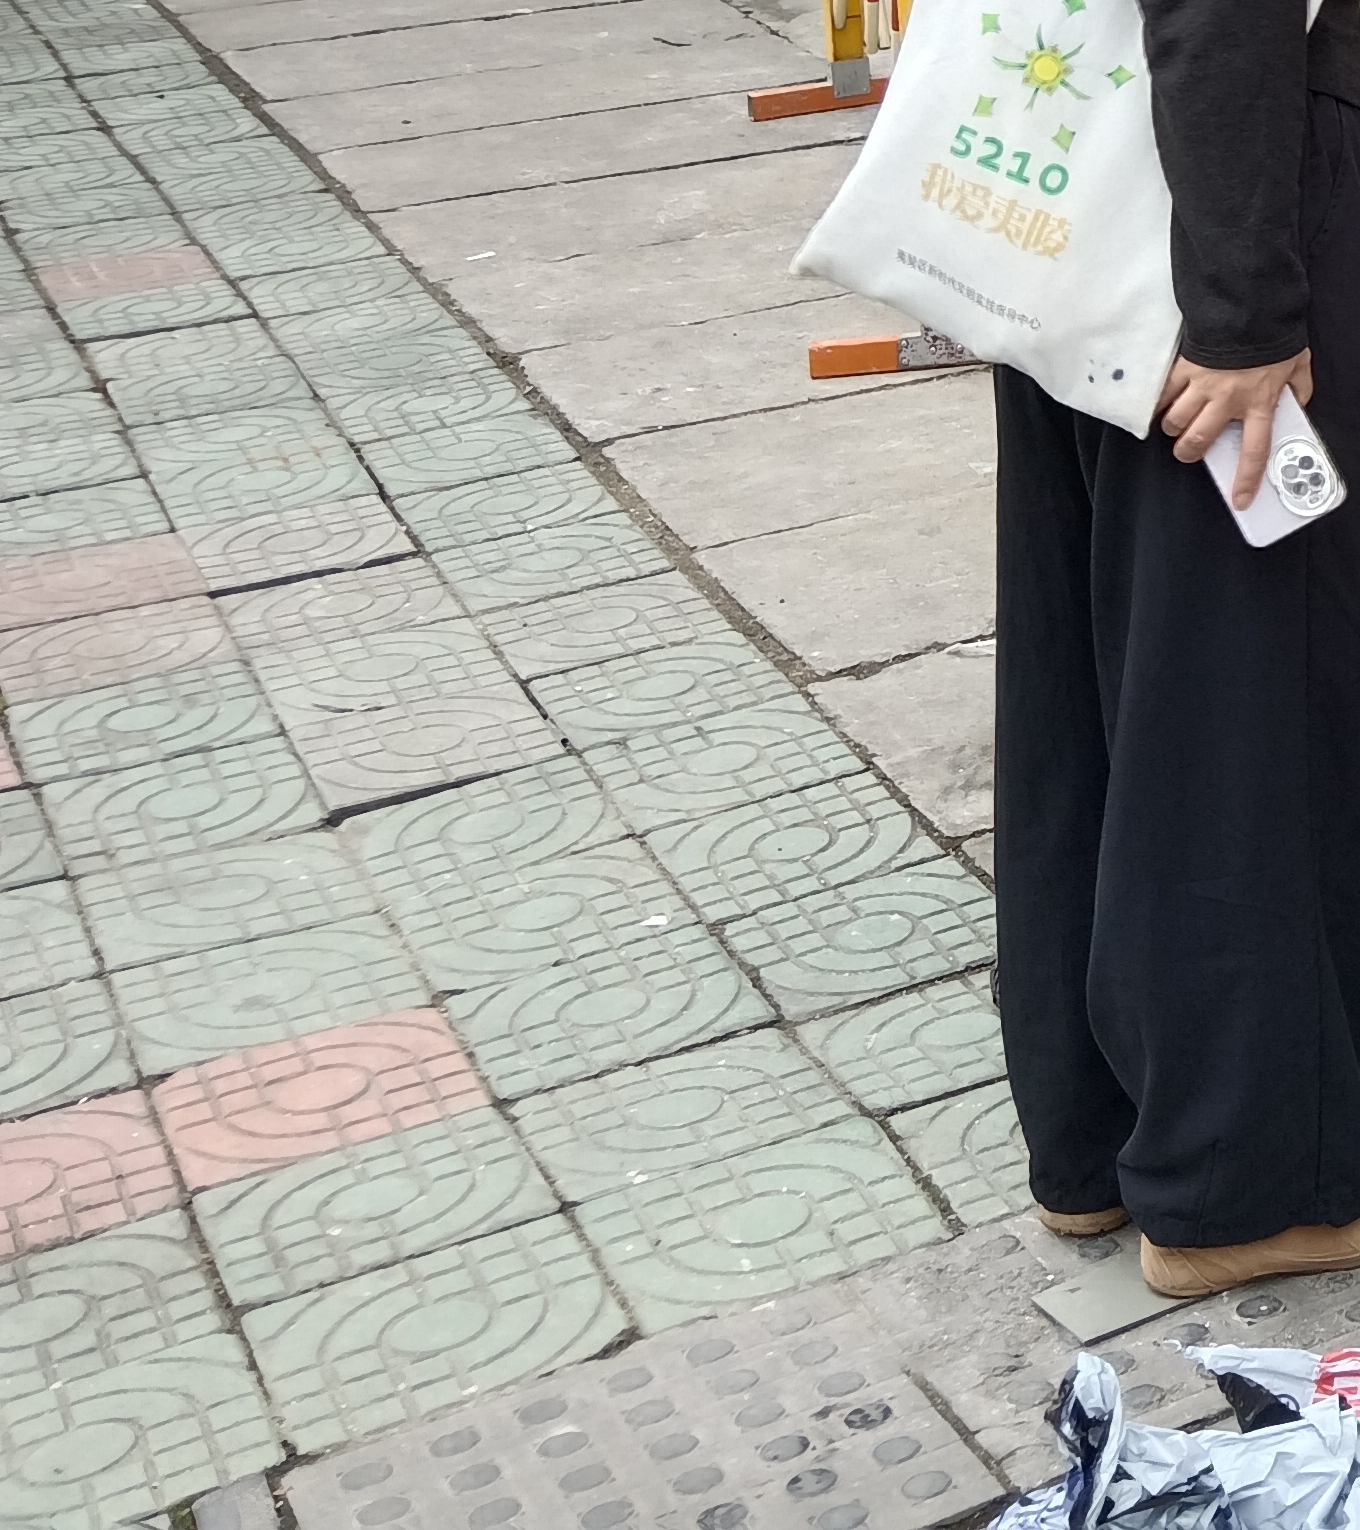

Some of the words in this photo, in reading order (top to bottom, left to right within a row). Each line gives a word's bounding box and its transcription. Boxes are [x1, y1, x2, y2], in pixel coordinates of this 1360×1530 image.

[948, 123, 1070, 197] 5210
[920, 160, 1074, 264] 我爱夷陵
